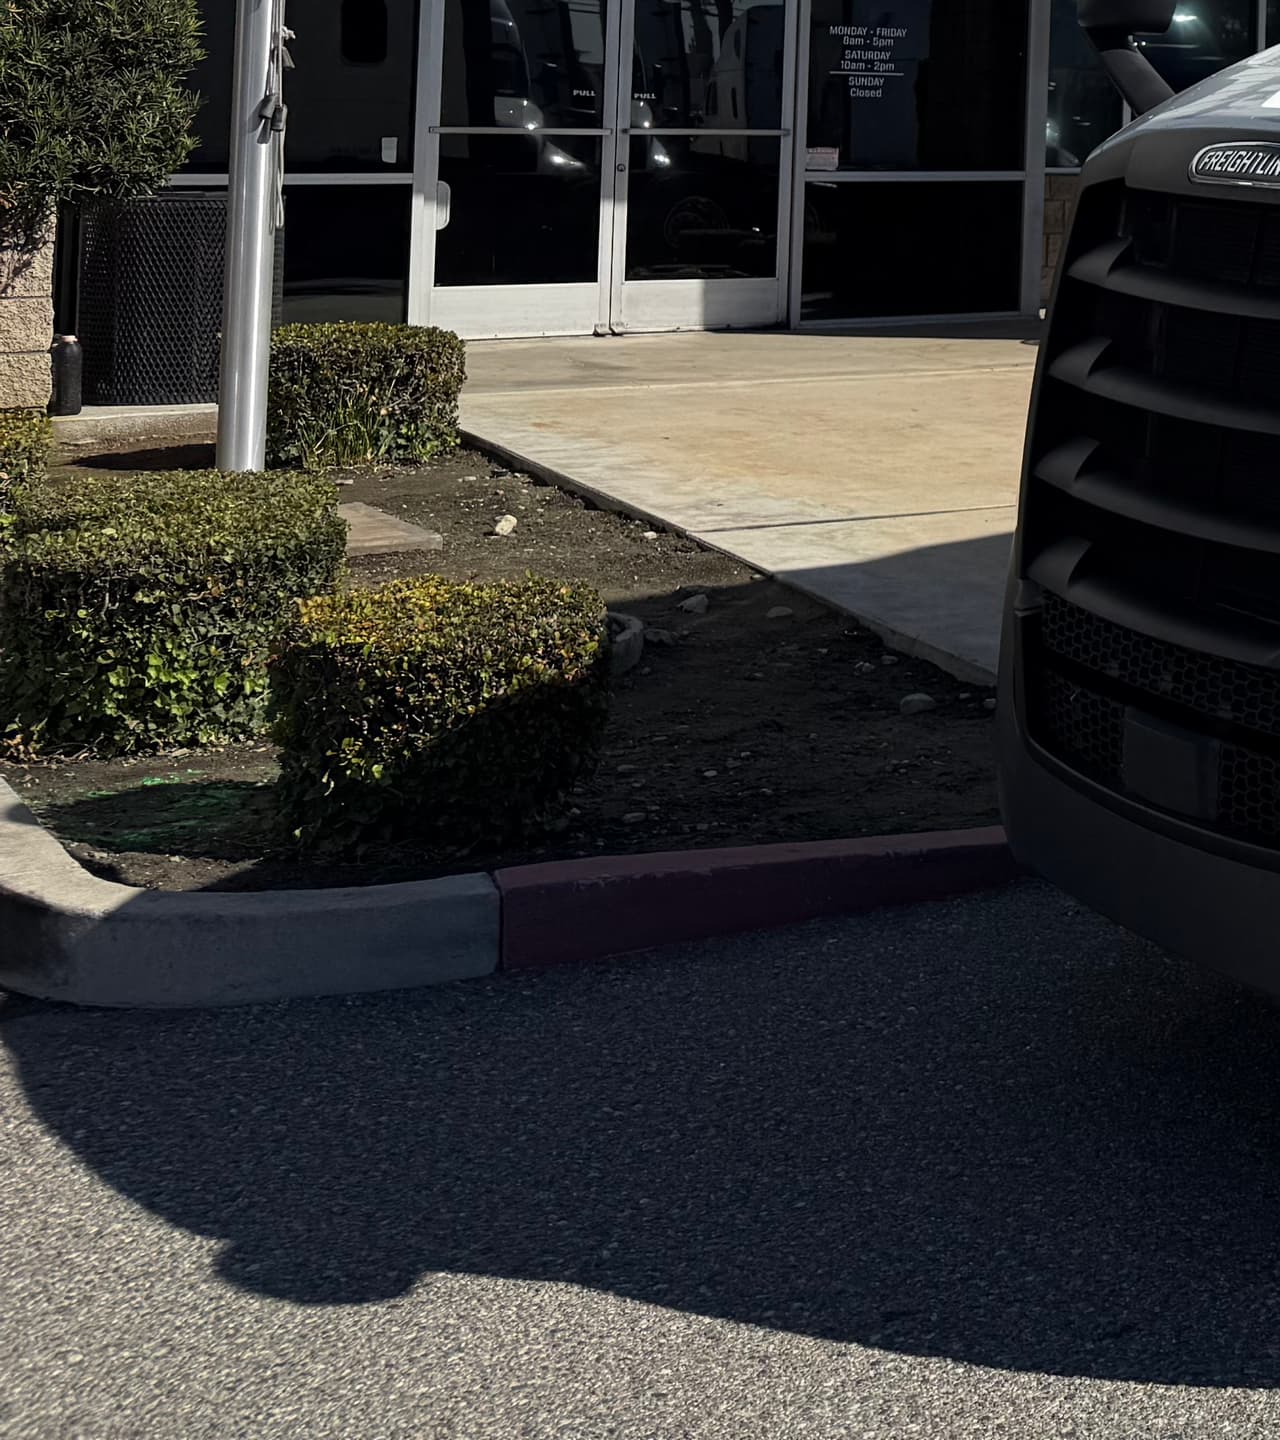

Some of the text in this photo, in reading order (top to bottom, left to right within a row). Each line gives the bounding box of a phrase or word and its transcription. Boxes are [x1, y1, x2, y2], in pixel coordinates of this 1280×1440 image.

[829, 25, 868, 36] MONDAY
[876, 27, 908, 37] FRIDAY
[873, 37, 894, 47] 5pm
[844, 50, 891, 60] SATURDAY
[840, 60, 865, 70] 10am
[874, 61, 895, 72] 2pm
[848, 76, 885, 86] SUNDAY
[573, 89, 596, 97] PULL
[850, 87, 882, 97] Closed
